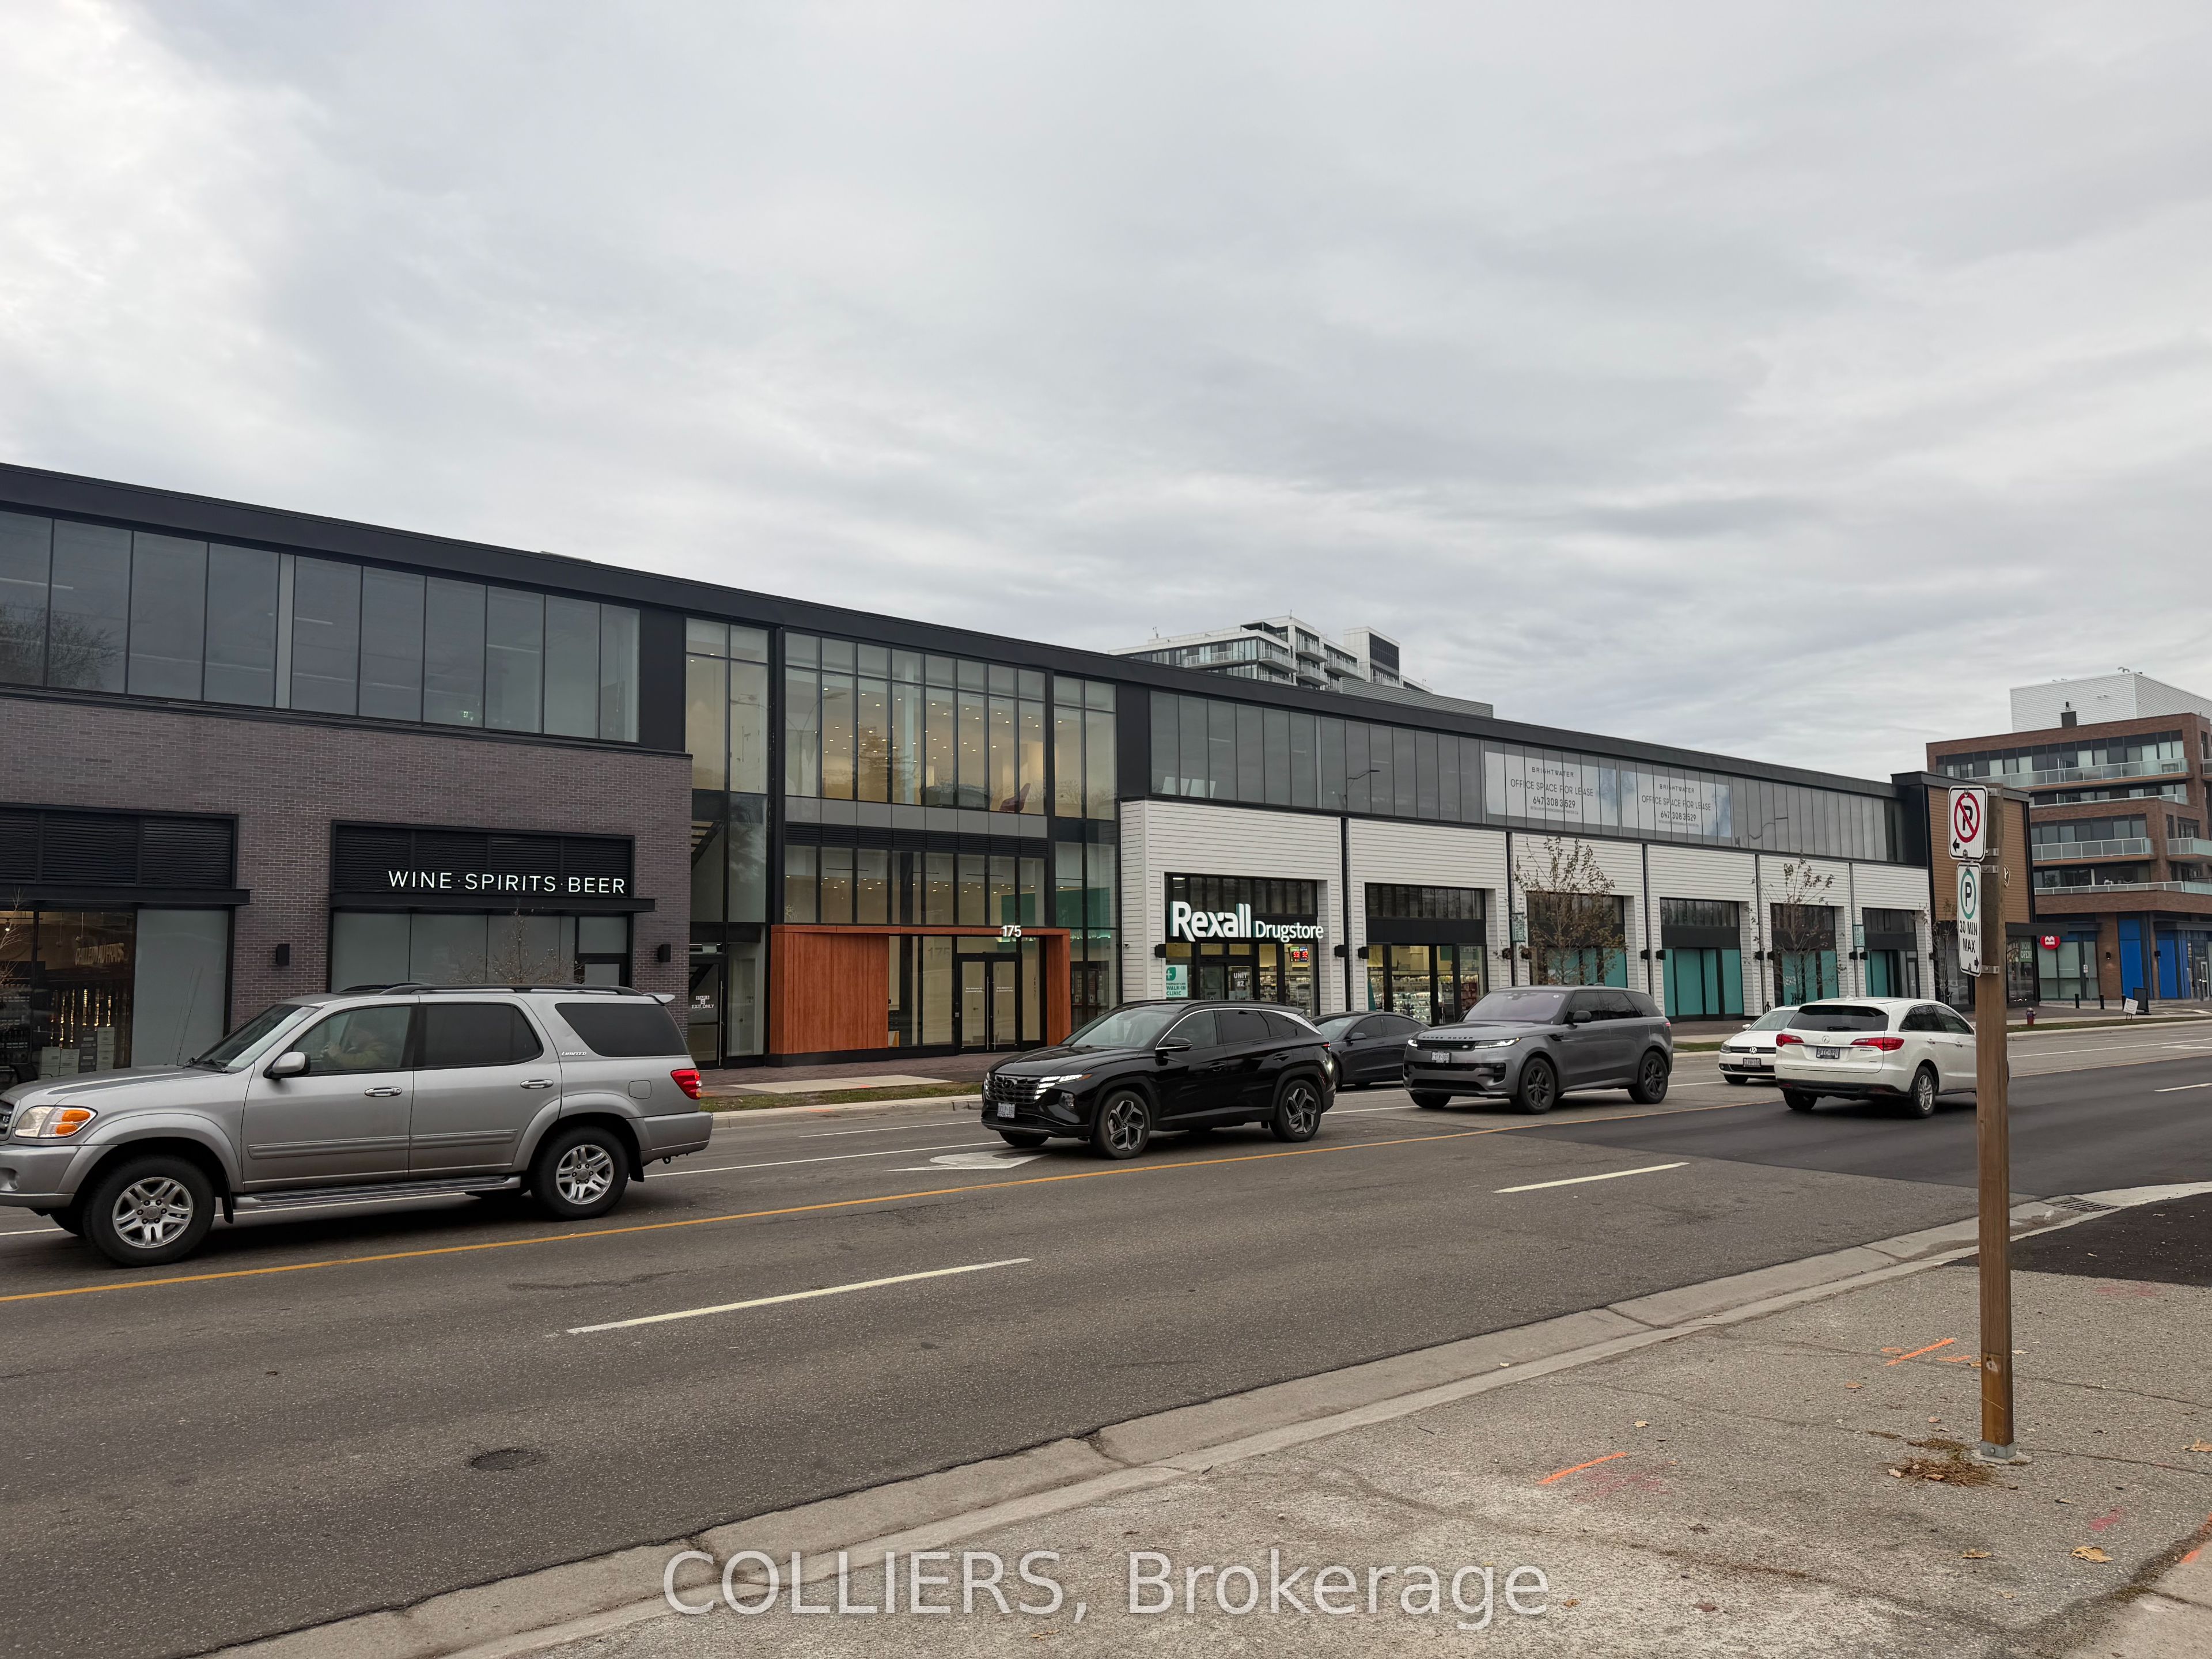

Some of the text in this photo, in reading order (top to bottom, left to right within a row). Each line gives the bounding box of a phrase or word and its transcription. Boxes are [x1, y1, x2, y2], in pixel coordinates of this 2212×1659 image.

[1532, 767, 1574, 778] BRIGHTWATER
[1510, 779, 1593, 797] OFFICE SPACE FOR LEASE
[1533, 796, 1575, 809] 647 308 3529
[1642, 795, 1711, 810] OFFICE SPACE FOR LEASE
[1672, 812, 1681, 820] 308
[388, 870, 624, 894] WINE SPIRITS BEER
[1171, 901, 1324, 943] Rexall Drugstore
[1960, 920, 1978, 936] 30 MIN
[1001, 925, 1022, 937] 175
[1963, 938, 1975, 953] MAX
